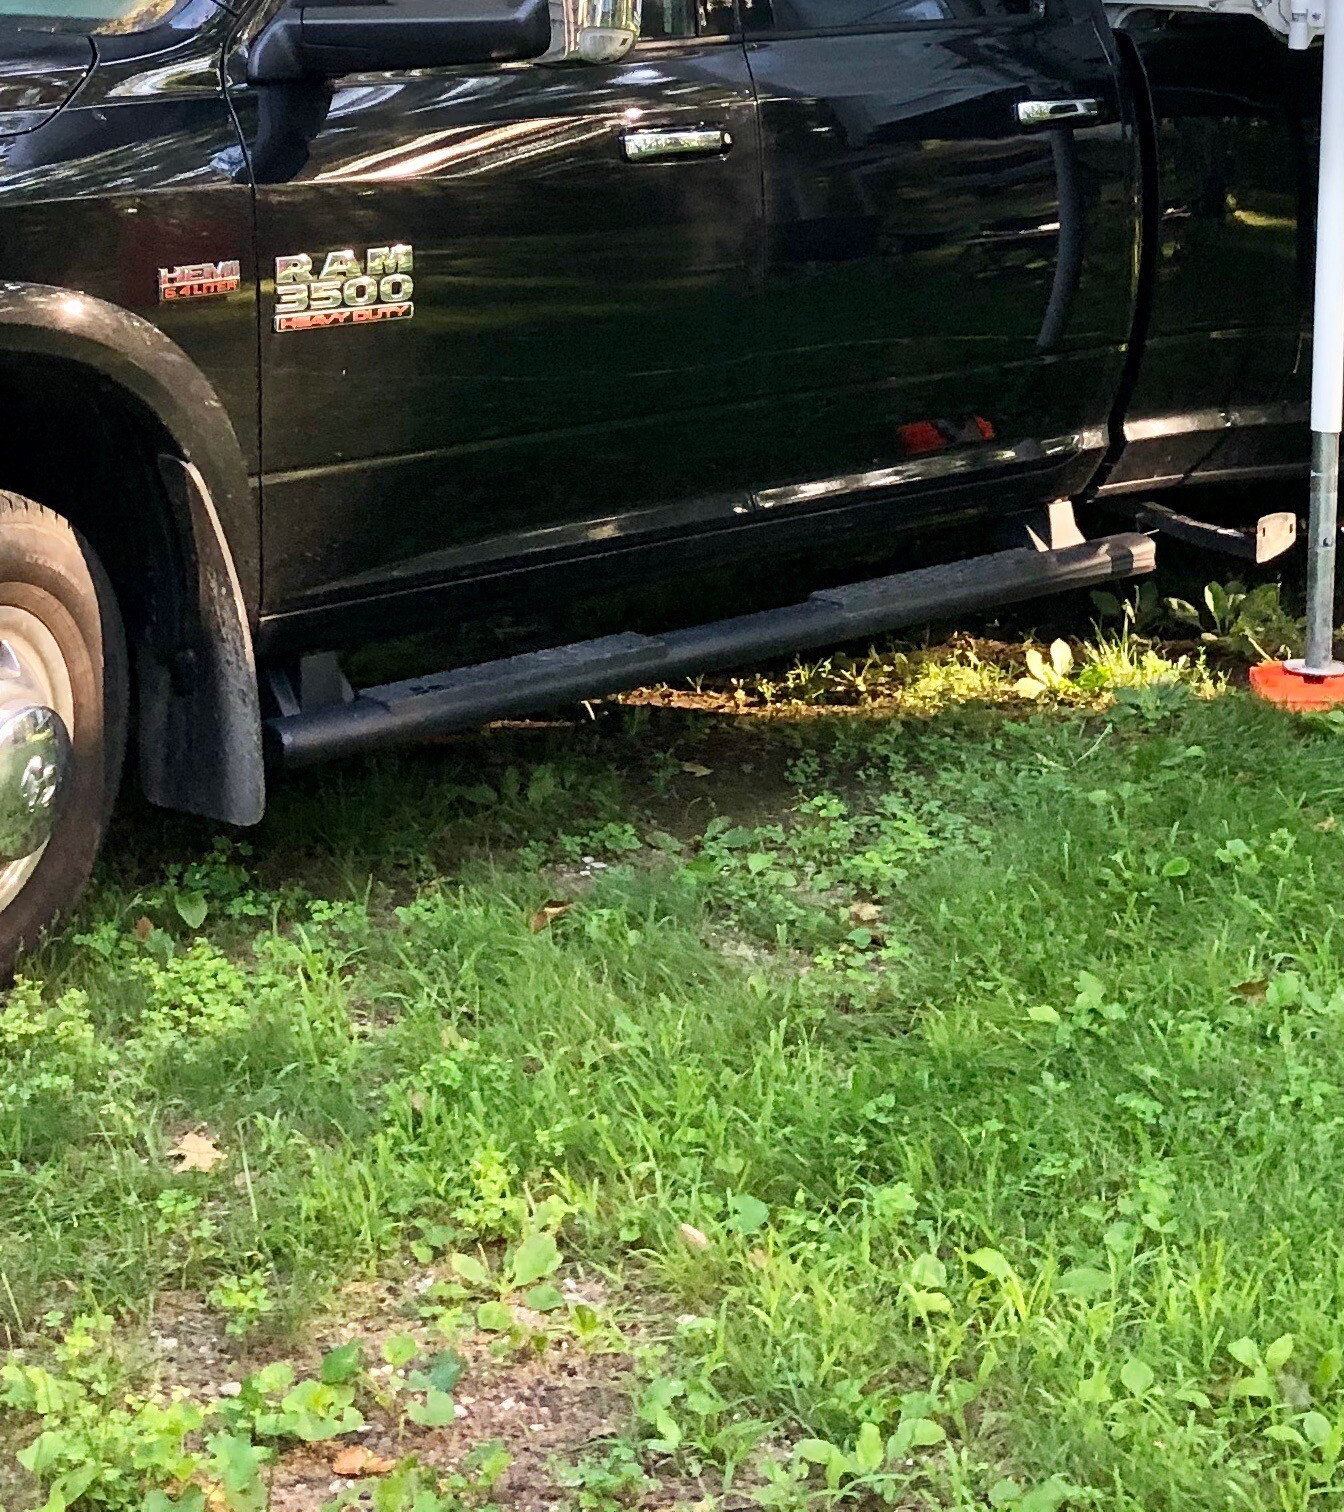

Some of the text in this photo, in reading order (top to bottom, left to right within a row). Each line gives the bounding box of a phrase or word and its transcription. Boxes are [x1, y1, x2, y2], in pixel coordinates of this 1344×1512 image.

[158, 260, 240, 285] HEMI
[275, 244, 413, 283] RAM
[275, 273, 413, 313] 3500
[280, 305, 409, 330] HEAVY DUTY
